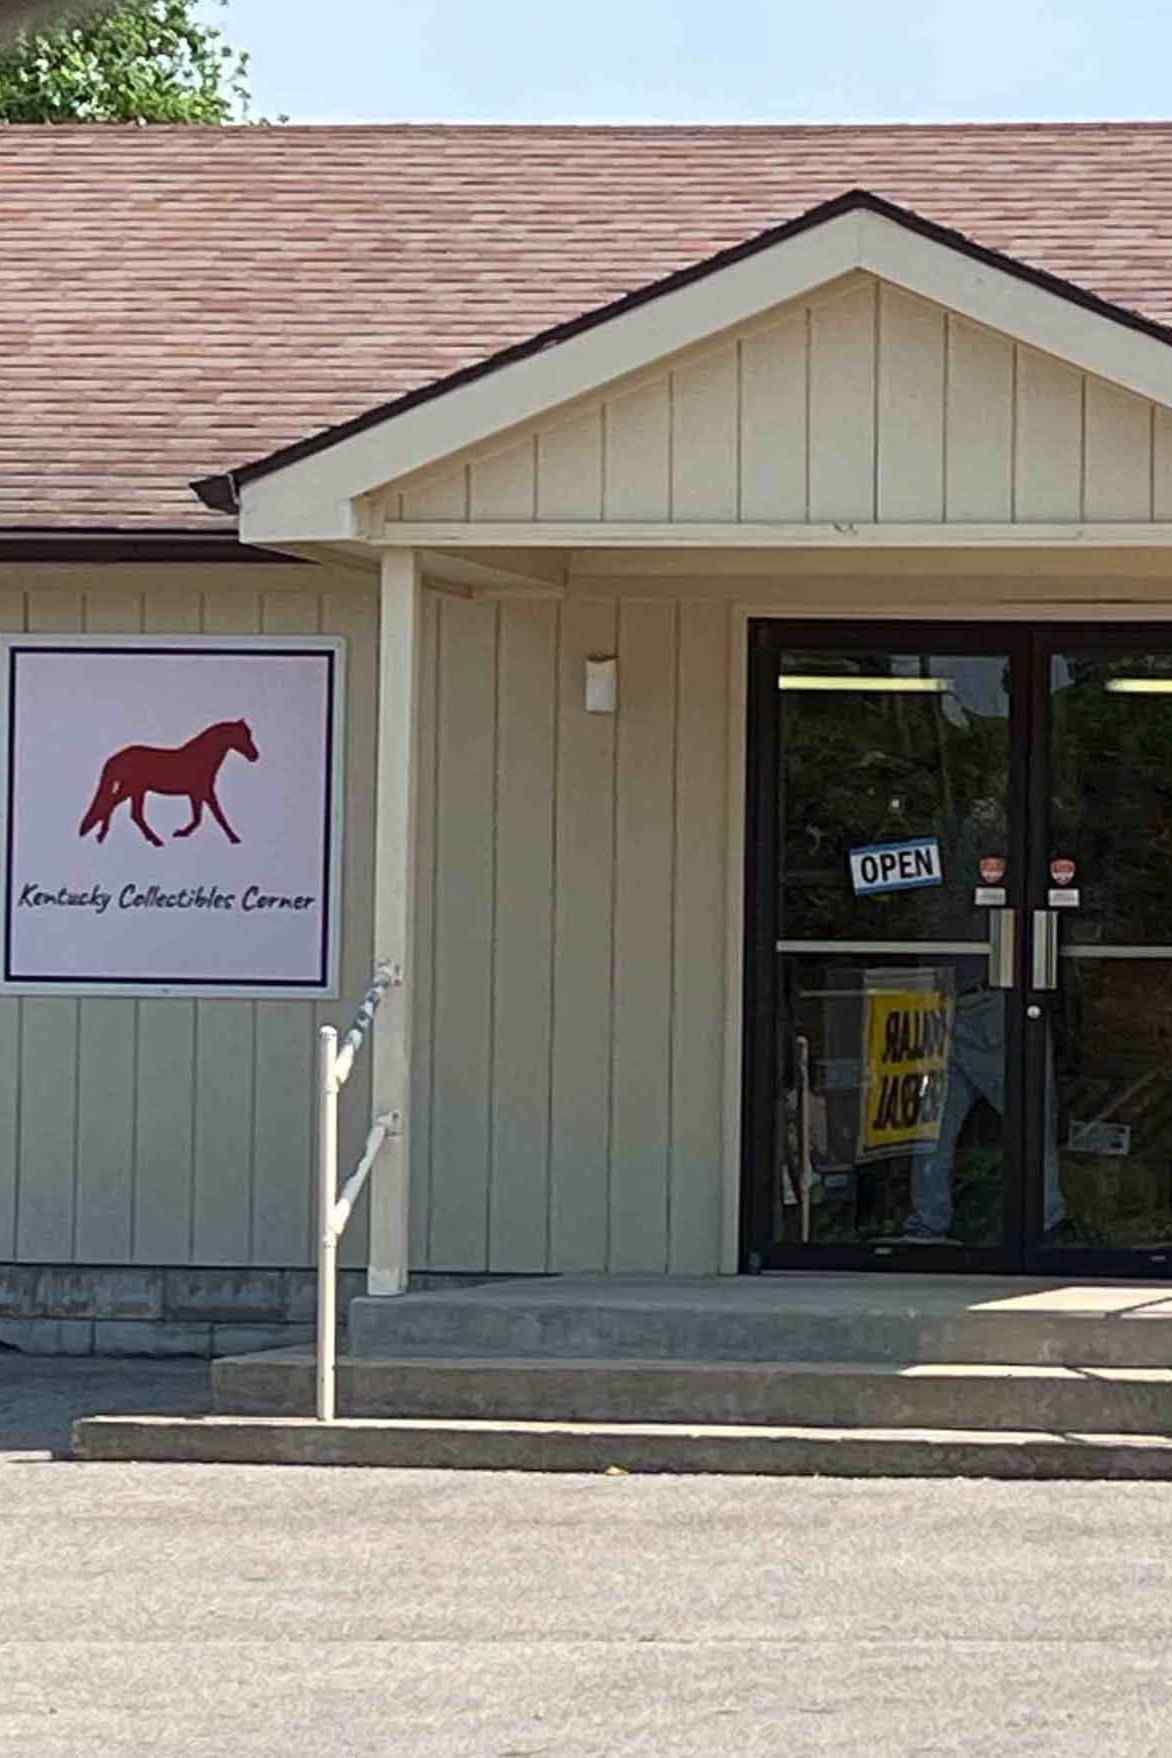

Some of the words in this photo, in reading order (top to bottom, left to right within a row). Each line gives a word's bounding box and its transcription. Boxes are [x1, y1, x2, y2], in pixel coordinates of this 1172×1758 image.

[861, 847, 934, 884] OPEN
[17, 882, 111, 913] Kentucky
[118, 882, 236, 910] Collectibles
[241, 885, 316, 911] Corner
